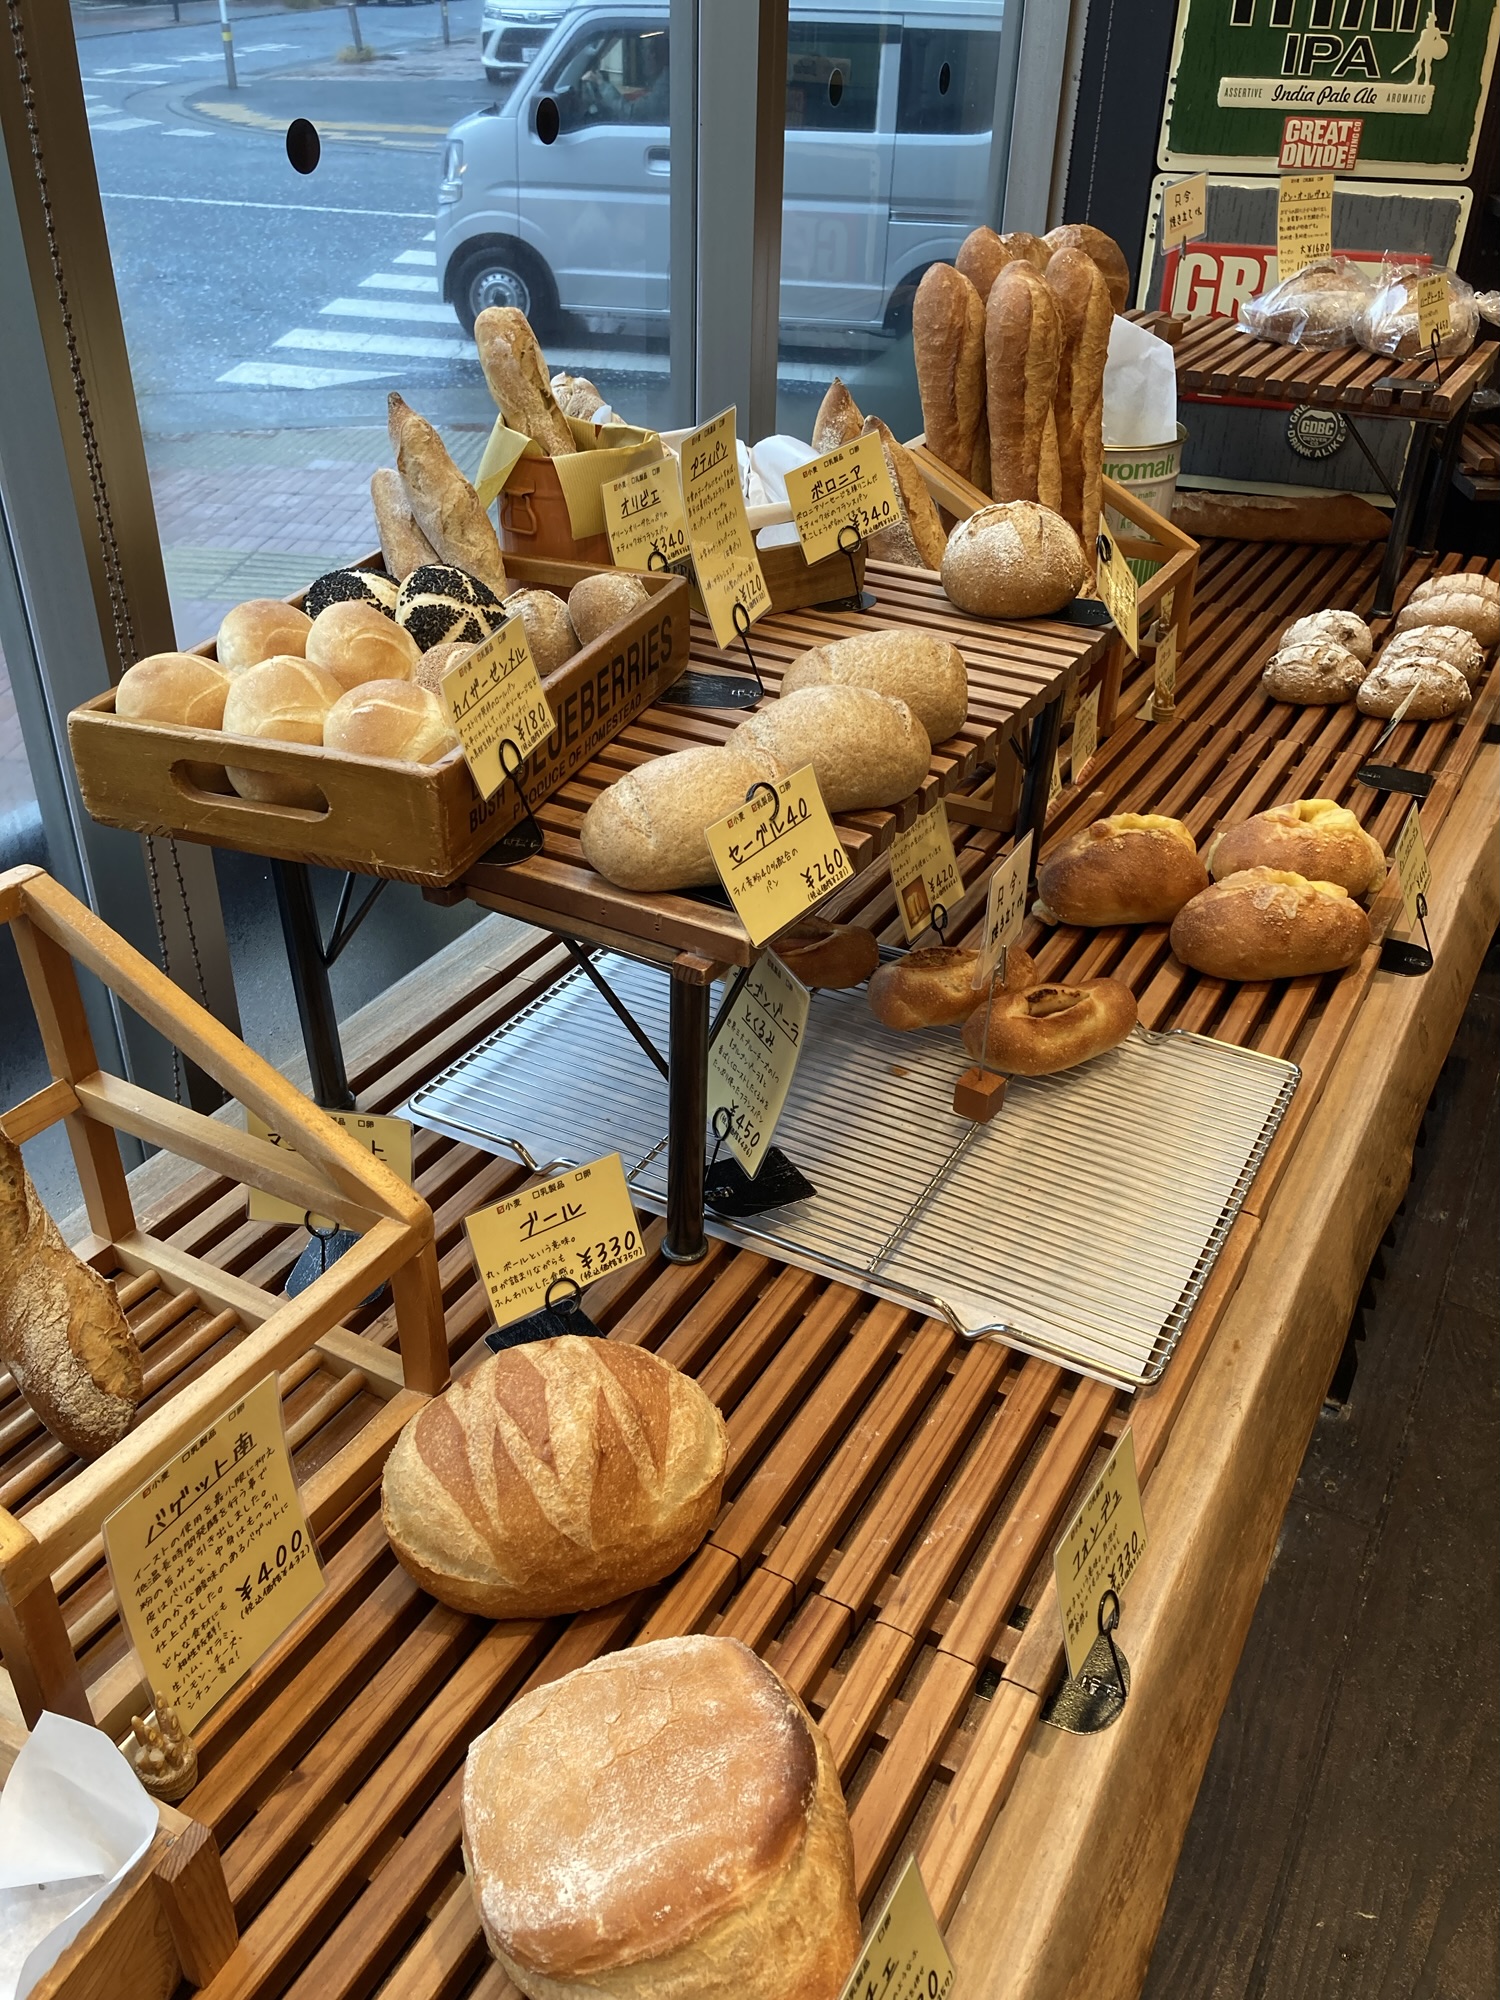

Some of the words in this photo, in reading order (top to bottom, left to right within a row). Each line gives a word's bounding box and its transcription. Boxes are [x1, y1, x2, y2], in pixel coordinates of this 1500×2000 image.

[1281, 33, 1381, 78] IPA
[1224, 87, 1263, 99] ASSERTIVE
[1271, 84, 1313, 103] India
[1317, 85, 1351, 105] Pale
[1353, 87, 1378, 104] Ale
[1386, 92, 1427, 104] AROMATIC
[1285, 119, 1353, 145] GREAT
[1280, 142, 1350, 168] DIVIDE
[1287, 430, 1313, 457] DRINK
[1314, 433, 1346, 457] ALIKE
[1300, 420, 1334, 435] GDBC
[690, 440, 728, 480] プティパン
[620, 488, 661, 517] オリビエ
[810, 464, 863, 500] ボロニア
[848, 500, 890, 532] ¥340
[649, 529, 684, 557] ¥340
[738, 573, 762, 606] ¥120
[452, 647, 526, 719] カイザーゼンメル
[513, 701, 546, 741] ¥180
[568, 745, 583, 767] OF
[585, 692, 642, 752] HOMESTEAD
[733, 811, 745, 824] 小麦
[755, 792, 774, 809] 乳製品
[728, 797, 811, 863] セーグル40
[733, 848, 798, 896] ライ麦粉40%配合の
[765, 879, 779, 893] パン
[799, 848, 843, 889] ¥260
[807, 865, 849, 902] (税込価格¥281)
[927, 863, 954, 893] ¥420
[745, 1004, 775, 1047] とくるみ
[729, 1099, 761, 1148] ¥450
[505, 1197, 522, 1211] 小麦
[539, 1179, 565, 1196] 乳製品
[582, 1168, 591, 1179] 卵
[519, 1202, 582, 1240] ブール
[485, 1236, 576, 1279] 丸、ボールという意味。
[575, 1230, 636, 1269] ¥330
[579, 1246, 643, 1282] (税込価格¥357)
[490, 1253, 565, 1294] 目が詰まりながらも
[494, 1266, 574, 1308] ふんわりとした食感。
[151, 1469, 170, 1490] 小麦
[190, 1428, 217, 1455] 乳製品
[147, 1432, 254, 1544] バゲット南
[133, 1447, 275, 1581] イーストの使用を最小限に抑え
[135, 1467, 267, 1596] 低温長時間発酵を行う事で
[139, 1489, 266, 1611] 粉の旨みを引き出しました。
[145, 1493, 278, 1625] 皮はバリッと、中身はもっちり
[150, 1502, 288, 1639] ほのかな酸味のあるバゲットに
[234, 1529, 302, 1602] ¥400
[1107, 1530, 1138, 1596] ¥330
[240, 1543, 310, 1620] (税込価格¥432)
[155, 1585, 223, 1653] 仕上げました。
[162, 1601, 227, 1669] どんな食材にも
[171, 1629, 234, 1693] 生ハム、サラミ、
[177, 1621, 221, 1672] 相性抜群!
[173, 1636, 242, 1707] サーモン、チーズ、
